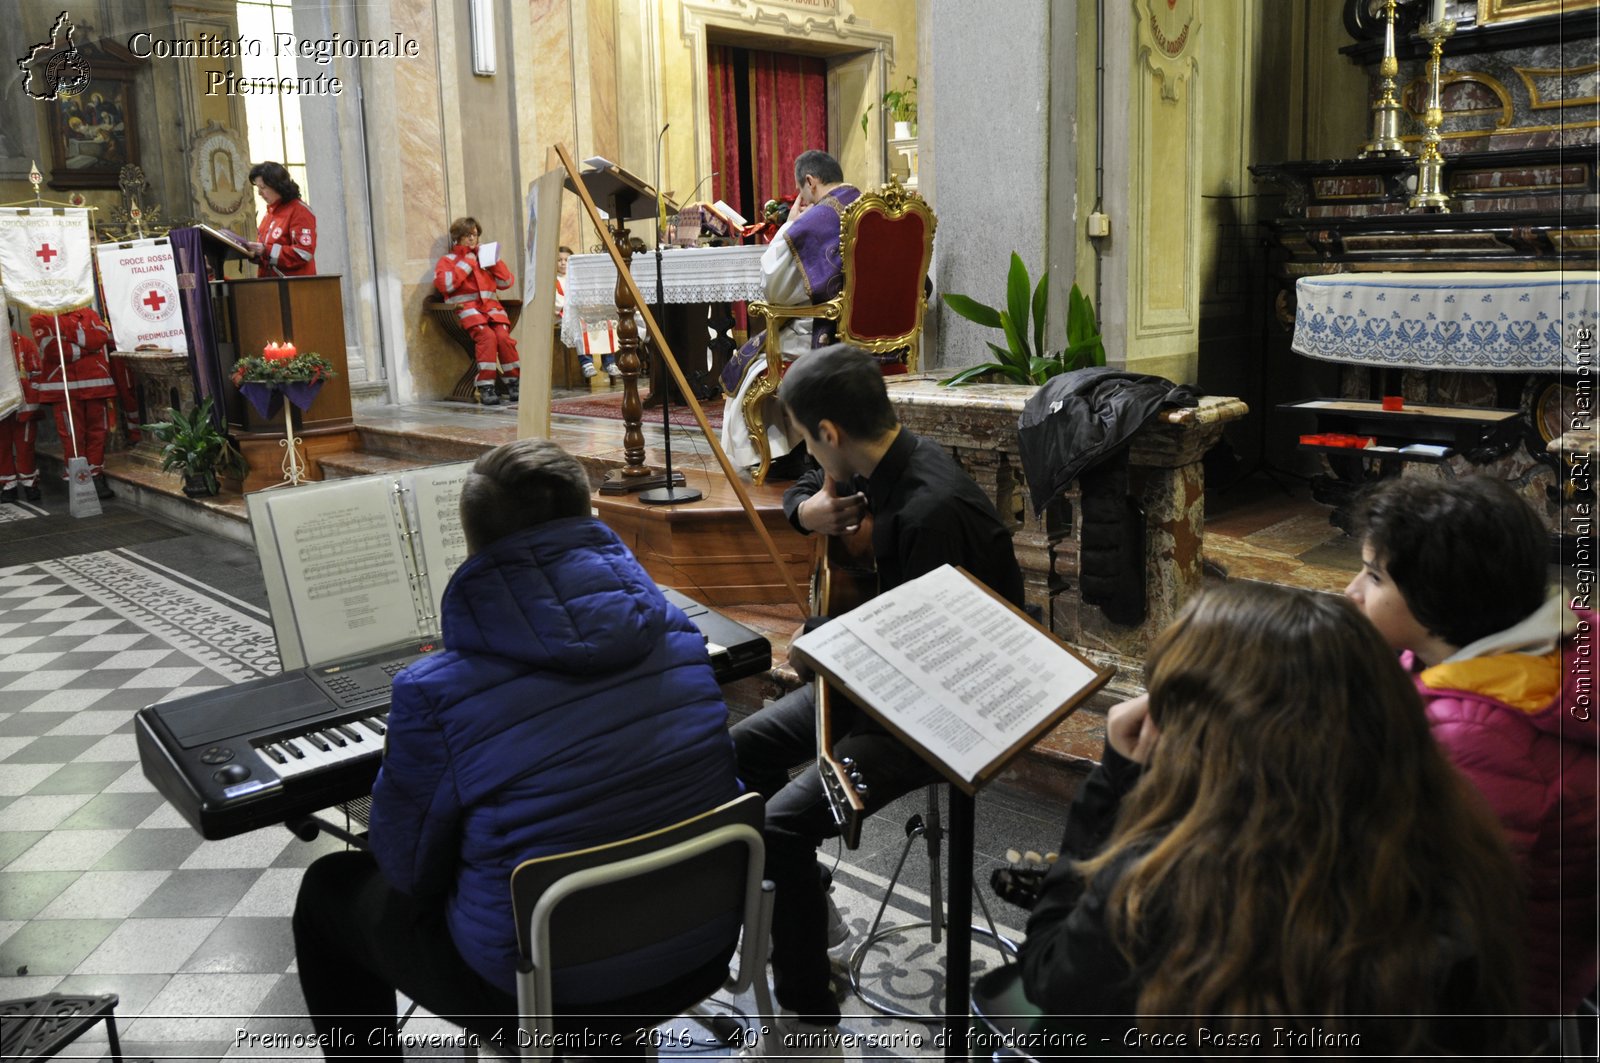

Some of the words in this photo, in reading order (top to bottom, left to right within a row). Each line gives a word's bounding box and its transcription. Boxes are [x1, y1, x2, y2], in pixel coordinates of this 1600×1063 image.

[120, 256, 145, 267] CROCE
[147, 253, 174, 263] ROSSA
[131, 264, 165, 275] ITALIANA
[137, 328, 185, 342] PIEDIMULERA
